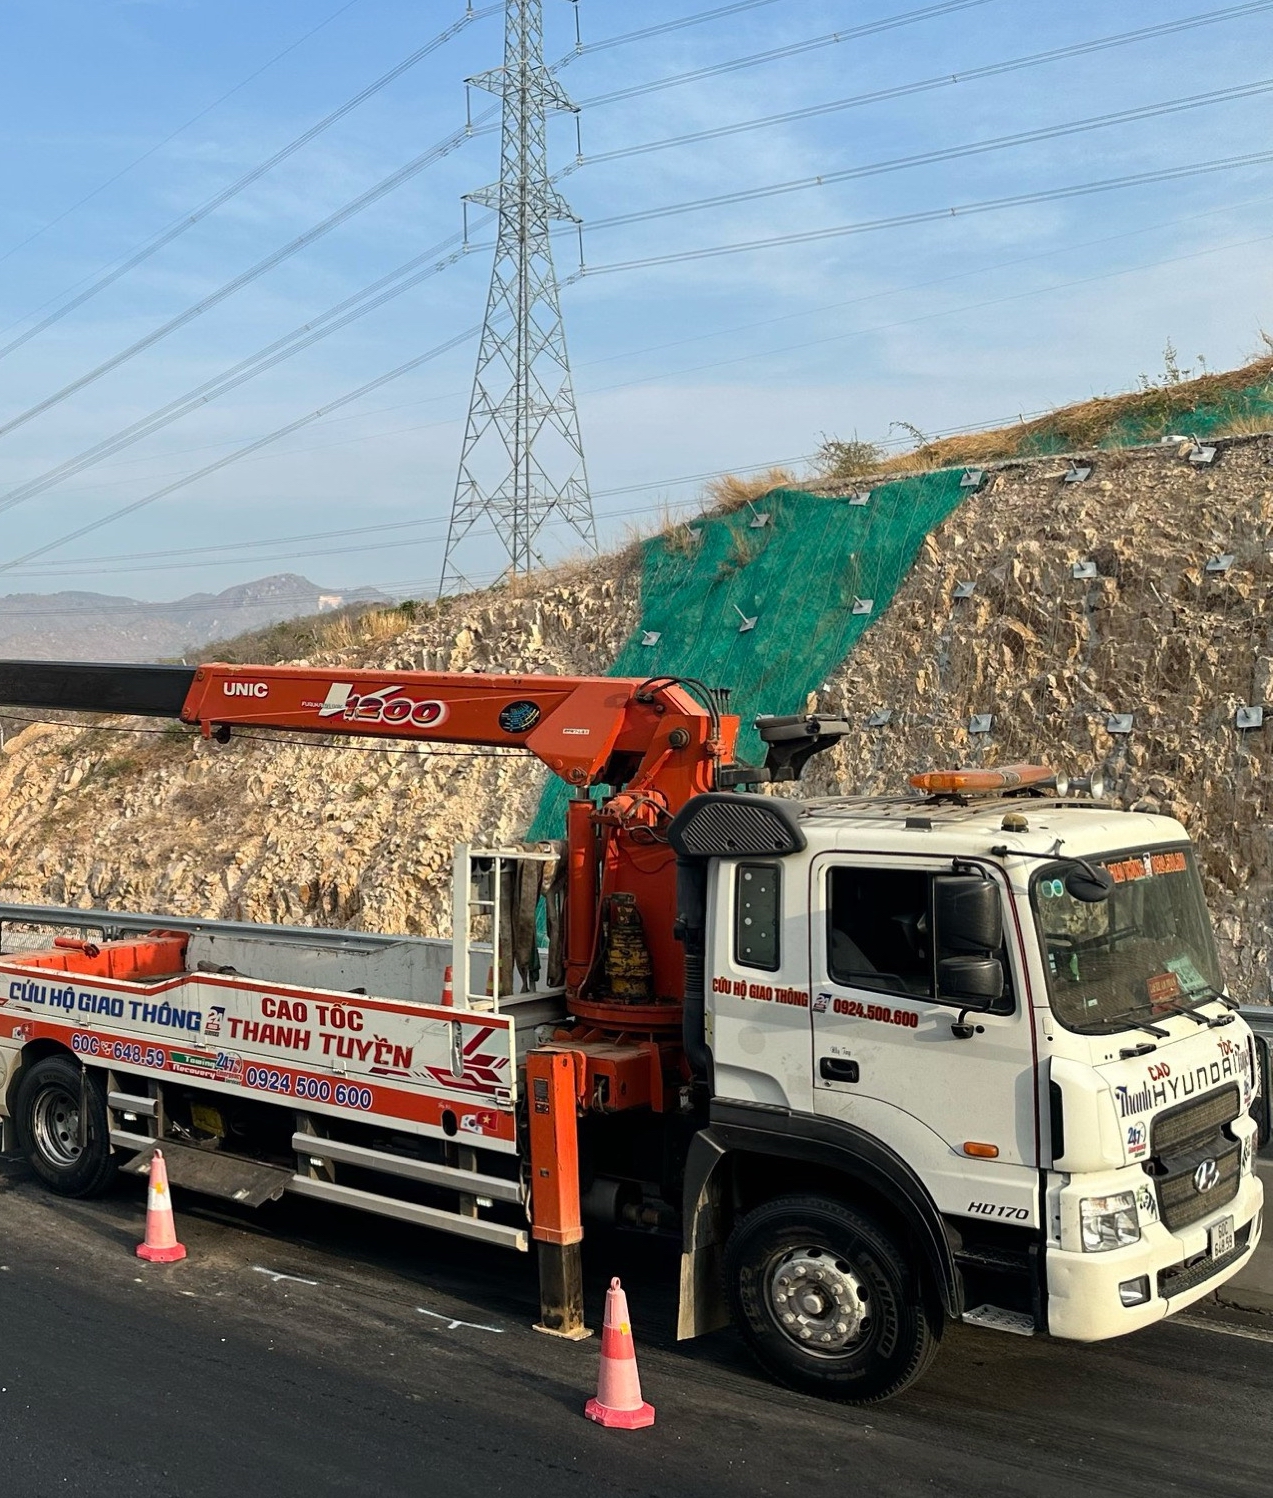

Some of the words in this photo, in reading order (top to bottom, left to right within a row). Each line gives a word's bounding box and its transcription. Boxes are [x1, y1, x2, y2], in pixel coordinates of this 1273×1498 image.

[223, 682, 269, 698] UNIC
[10, 979, 47, 1005] CỨU
[50, 986, 76, 1013] HỘ
[78, 993, 124, 1018] GIAO
[128, 1000, 202, 1032] THÔNG
[712, 976, 731, 995] CỨU
[733, 980, 747, 1000] HỘ
[749, 984, 773, 1001] GIAO
[774, 987, 809, 1008] THÔNG
[261, 997, 308, 1023] CAO
[315, 1001, 364, 1032] TỐC
[833, 998, 919, 1029] 0924.500.600
[71, 1032, 101, 1055] 60C
[113, 1041, 166, 1069] 648.59
[227, 1017, 311, 1051] THANH
[319, 1033, 413, 1069] TUYỀN
[172, 1063, 216, 1080] Recovery
[184, 1055, 216, 1069] Towing
[1147, 1062, 1171, 1082] CAO
[246, 1066, 292, 1094] 0924
[294, 1076, 331, 1102] 500
[334, 1083, 374, 1110] 600
[1152, 1053, 1238, 1107] HYUNDAI
